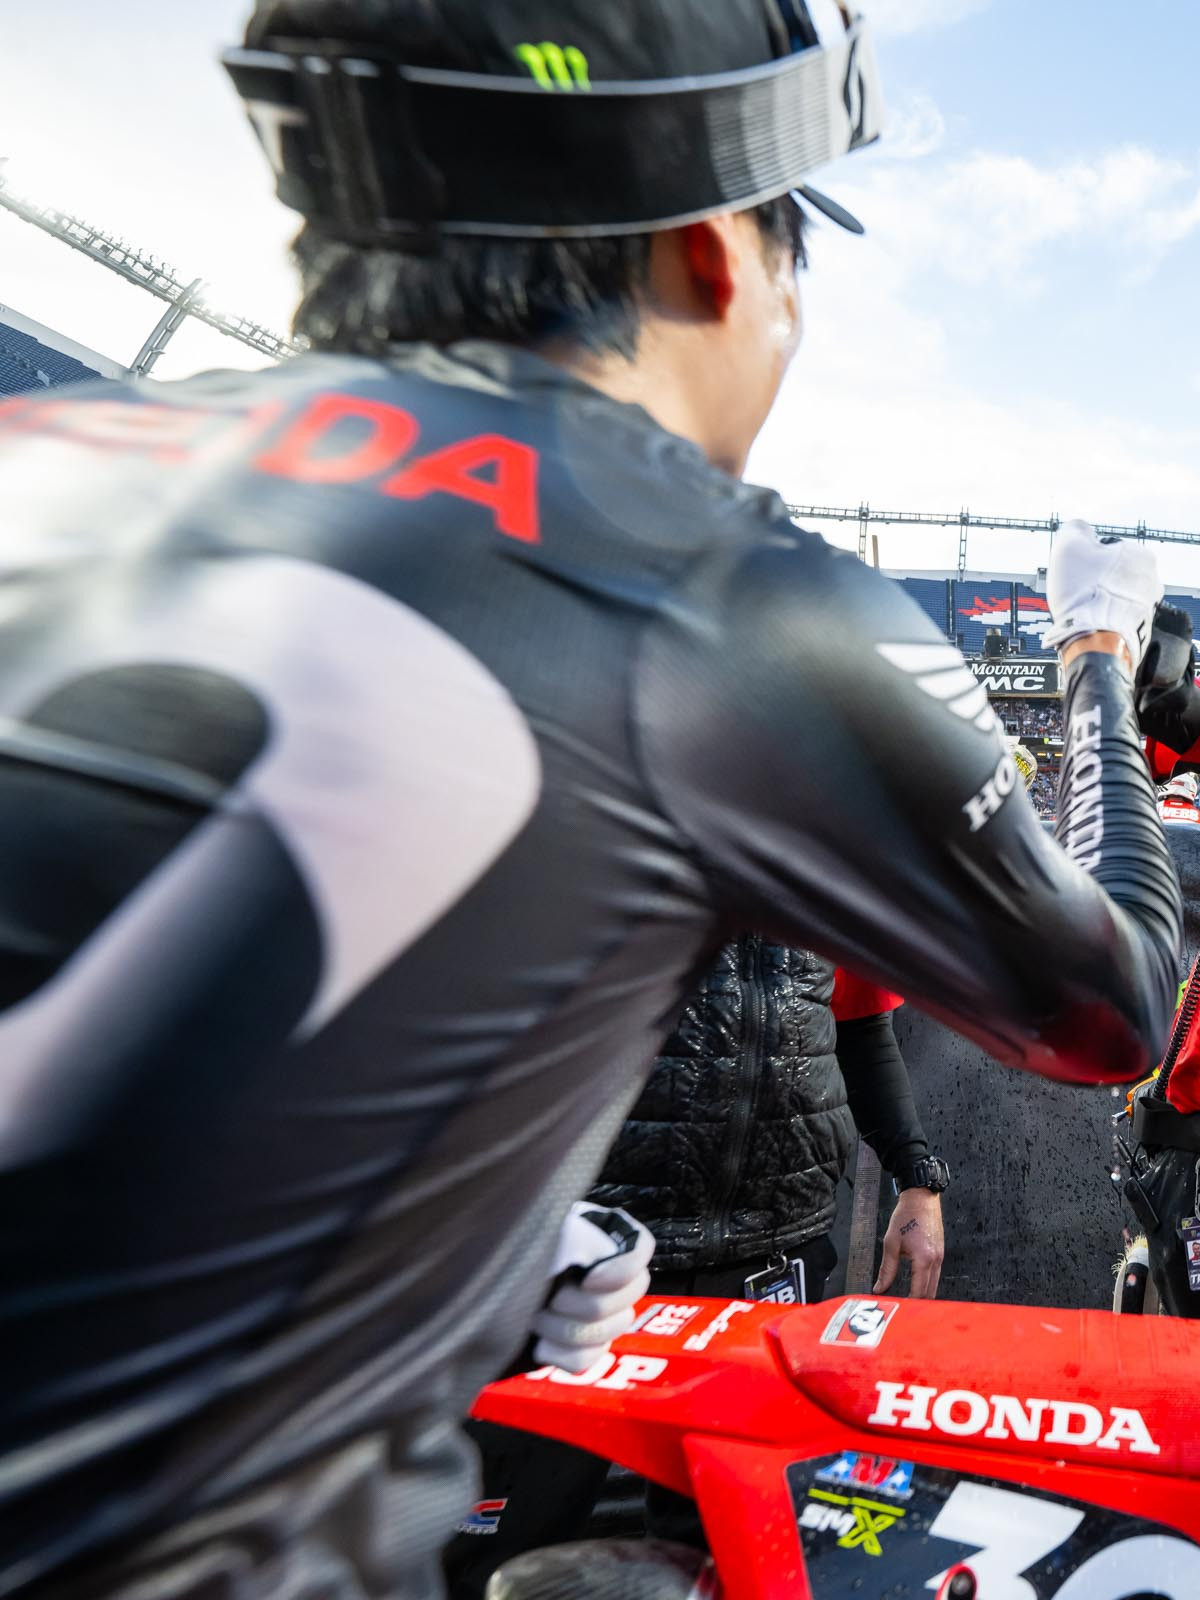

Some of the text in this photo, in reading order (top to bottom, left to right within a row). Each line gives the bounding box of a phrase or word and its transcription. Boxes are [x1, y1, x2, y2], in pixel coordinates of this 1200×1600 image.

[970, 663, 1046, 676] MOUNTAIN
[1158, 806, 1199, 820] WEBB
[866, 1381, 1161, 1456] HONDA
[814, 1449, 916, 1500] AMA
[797, 1504, 897, 1557] SMX
